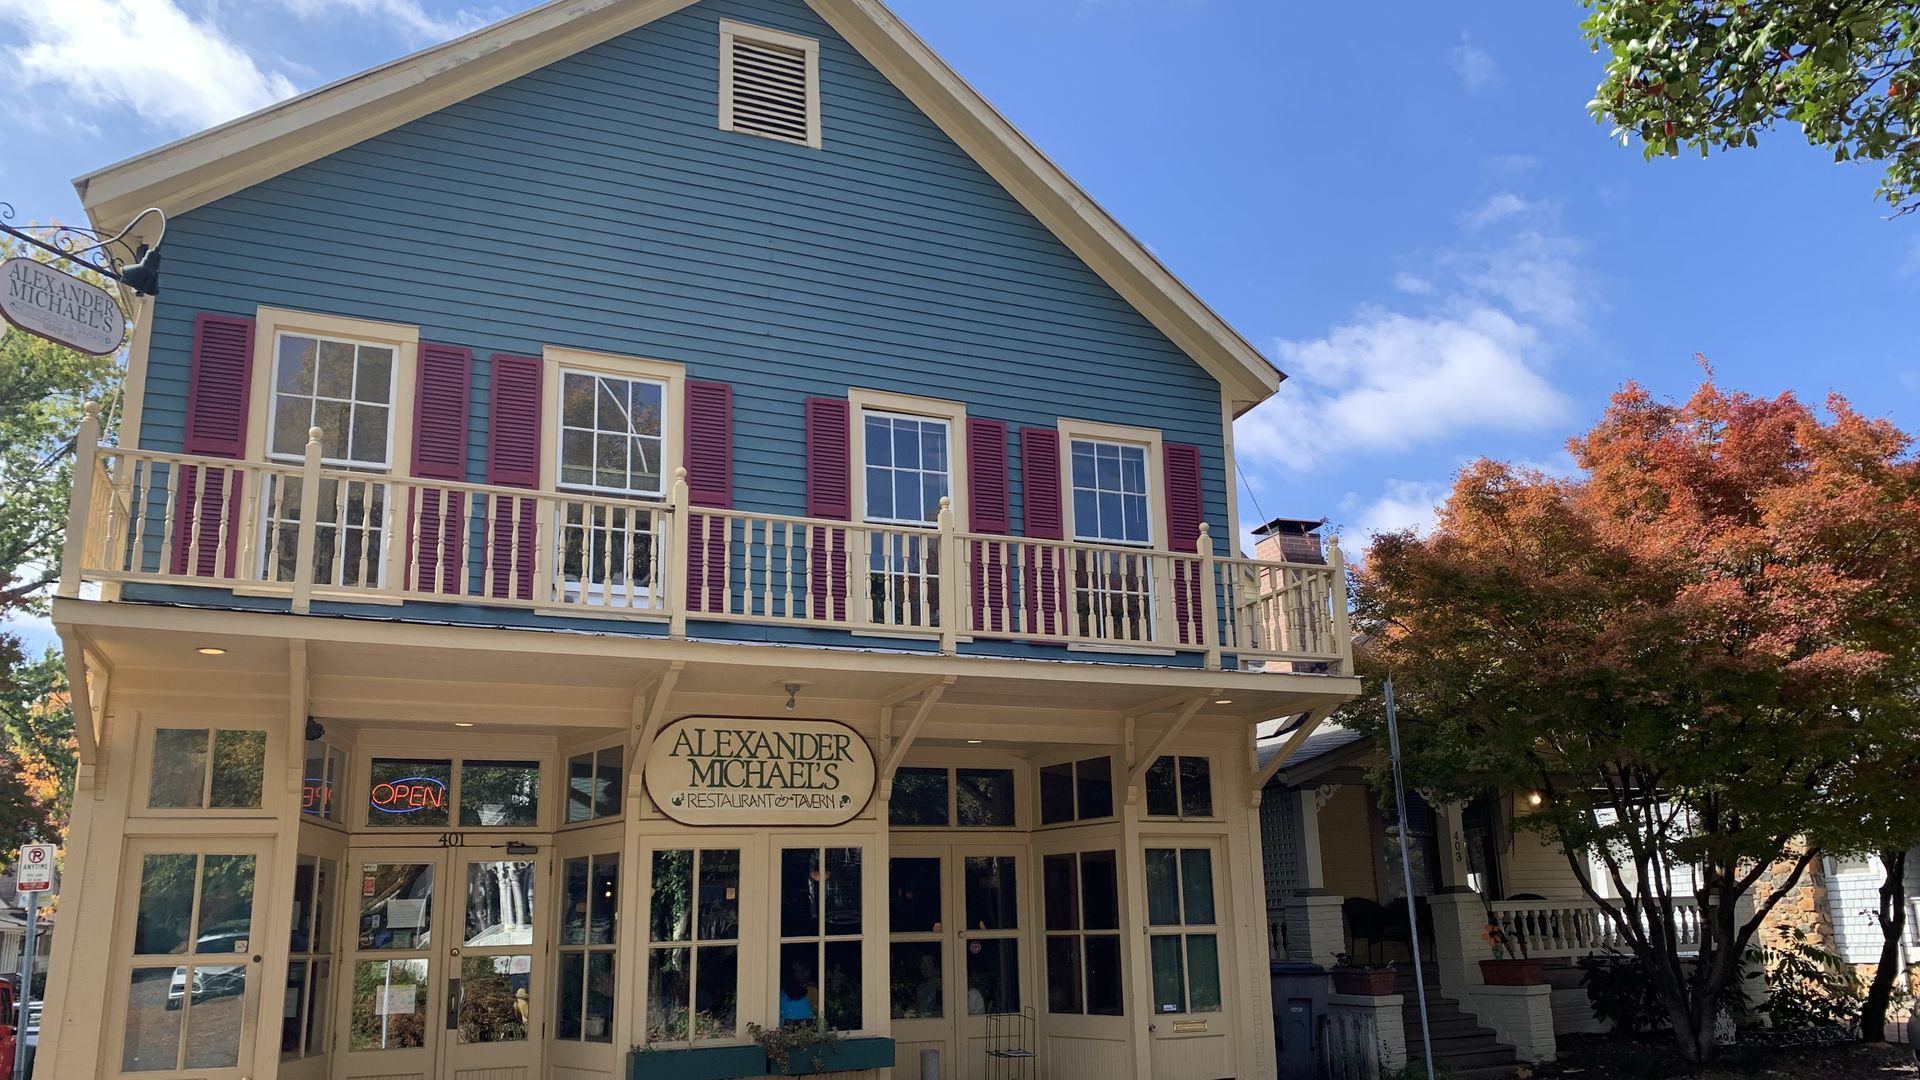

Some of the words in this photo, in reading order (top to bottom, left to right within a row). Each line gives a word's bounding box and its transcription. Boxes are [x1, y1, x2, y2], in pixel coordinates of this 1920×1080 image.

[9, 262, 114, 318] ALEXANDER
[9, 280, 112, 333] MICHAEL'S
[669, 728, 854, 762] ALEXANDER
[687, 758, 839, 790] MICHAEL'S
[372, 783, 443, 807] OPEN
[687, 793, 775, 808] RESTAURANT
[792, 794, 835, 809] TAVERN
[438, 832, 464, 848] 401
[1453, 832, 1462, 861] 403
